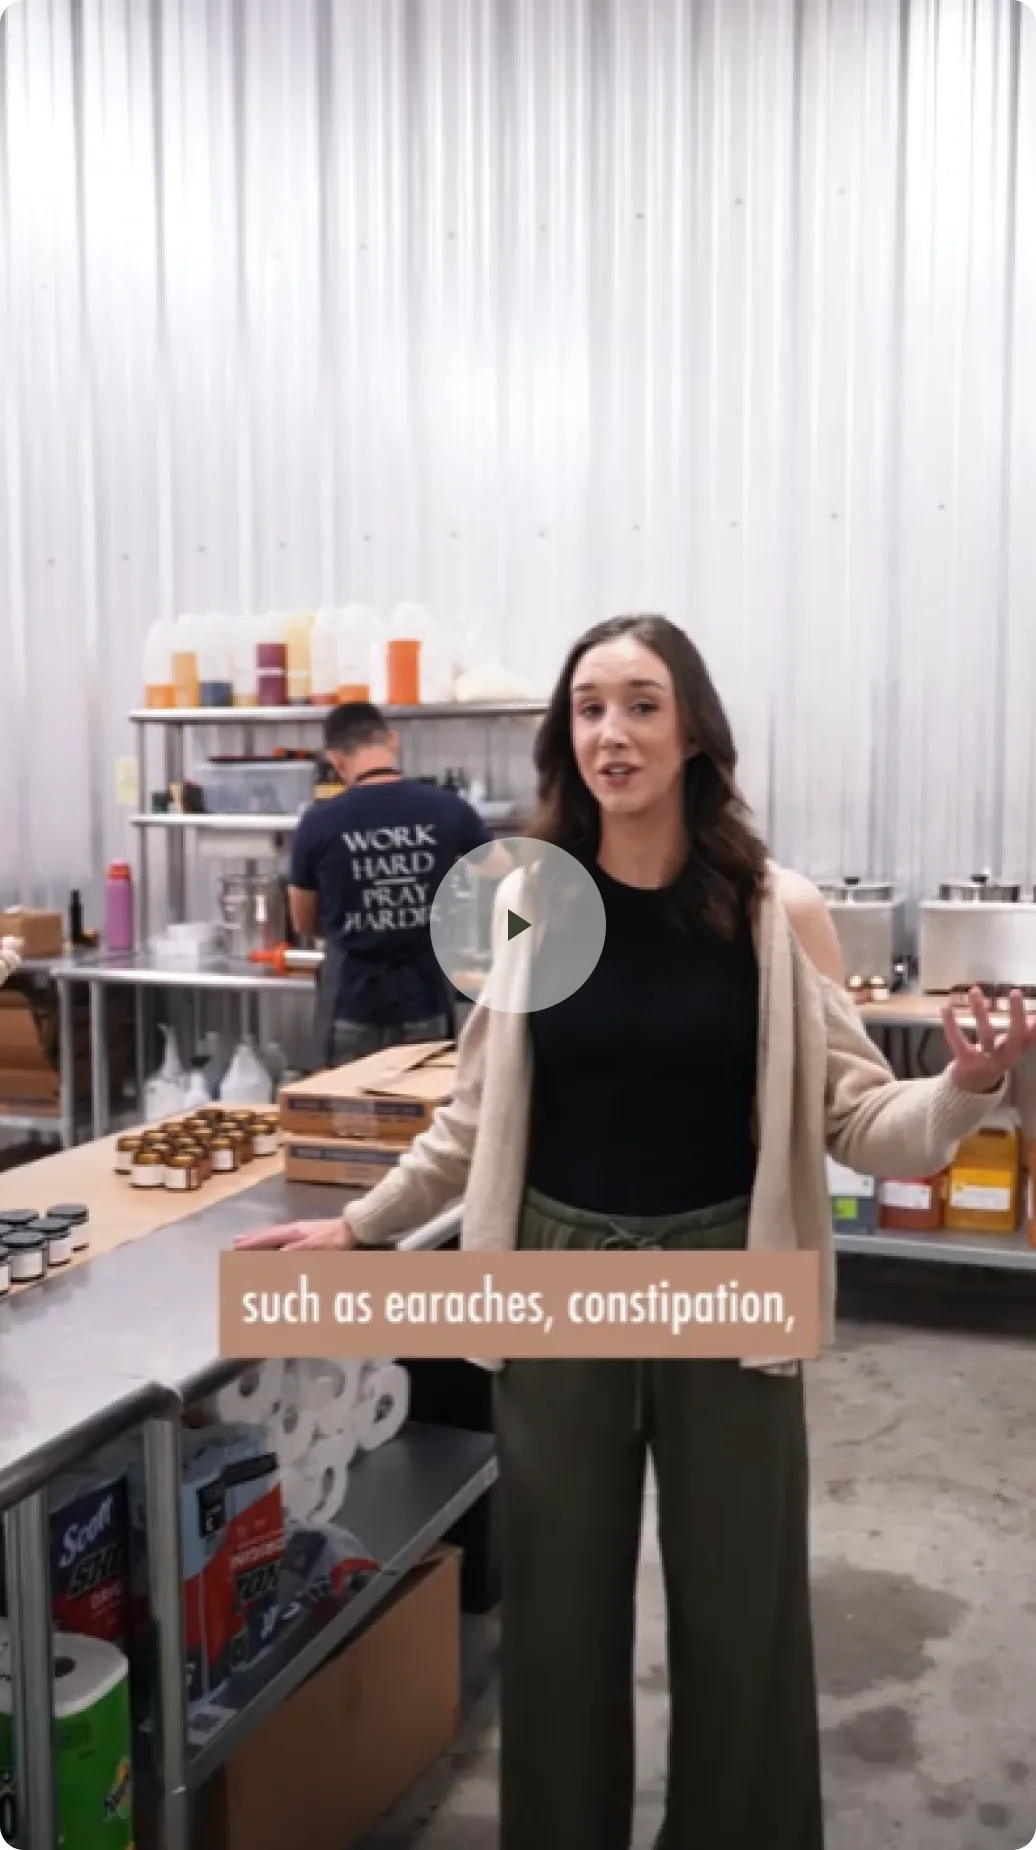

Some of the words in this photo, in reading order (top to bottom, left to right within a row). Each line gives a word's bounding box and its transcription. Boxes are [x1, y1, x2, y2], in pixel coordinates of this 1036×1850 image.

[341, 824, 437, 851] WORK
[352, 852, 435, 880] HARD
[363, 882, 429, 908] PRAY
